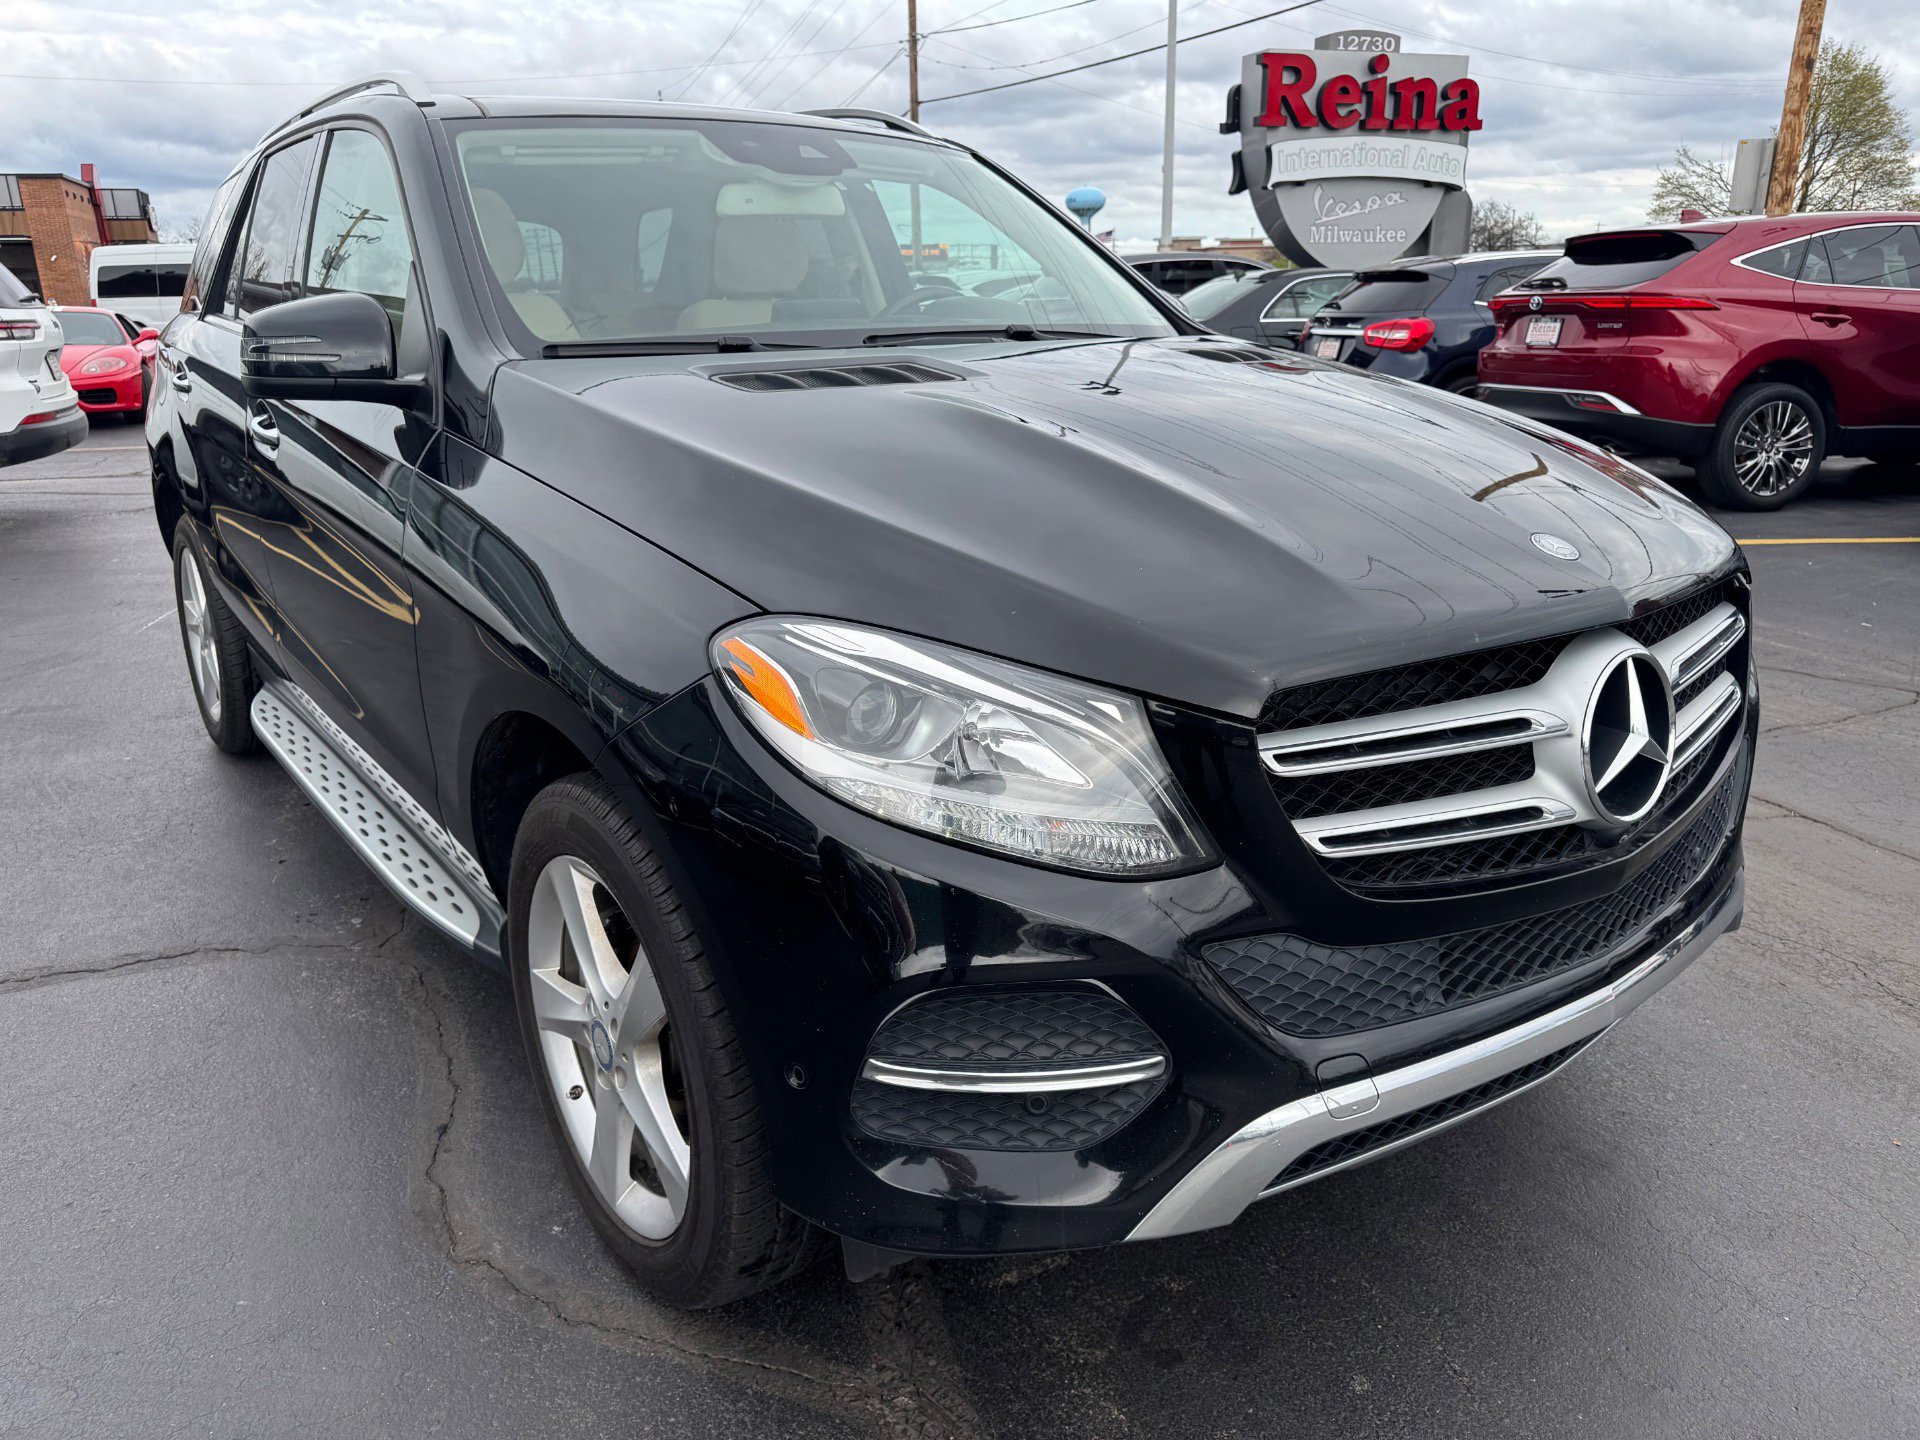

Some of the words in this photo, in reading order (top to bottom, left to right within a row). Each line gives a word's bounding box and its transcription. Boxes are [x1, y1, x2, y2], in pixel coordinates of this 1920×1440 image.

[1337, 35, 1396, 52] 12730
[1255, 52, 1483, 131] Reina
[1278, 142, 1409, 174] International
[1413, 146, 1461, 177] Auto
[1313, 184, 1407, 223] Vespa
[1309, 225, 1406, 243] Milwaukee
[1532, 323, 1557, 333] Reina
